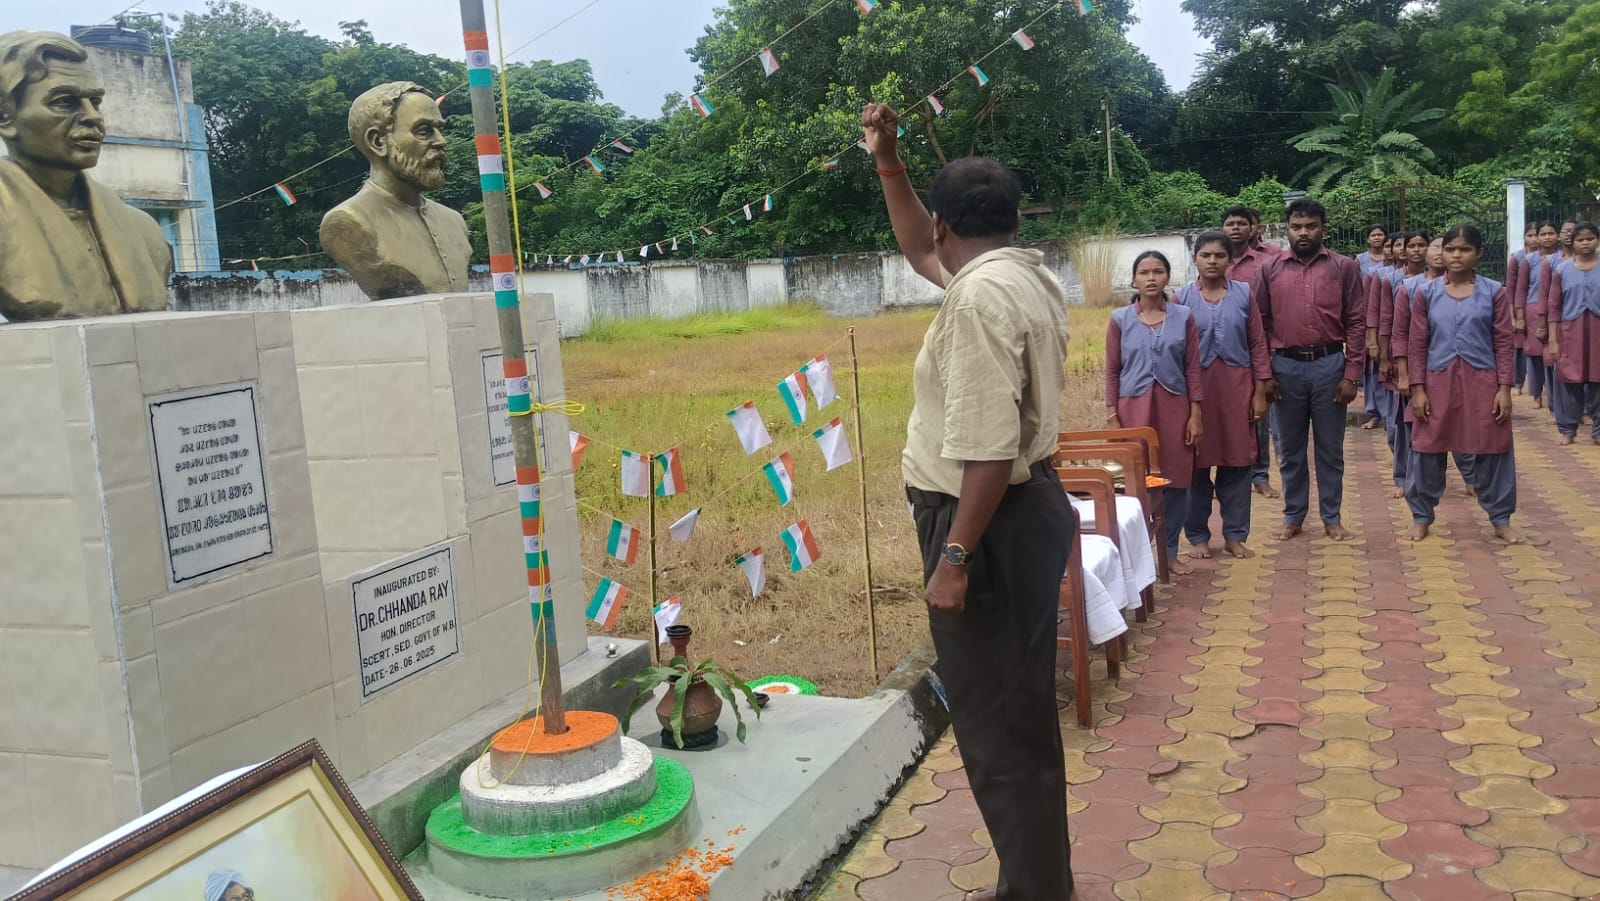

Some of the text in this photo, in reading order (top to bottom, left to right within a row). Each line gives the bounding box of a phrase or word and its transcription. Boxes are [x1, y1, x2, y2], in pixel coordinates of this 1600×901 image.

[374, 570, 426, 599] INAUGURATED
[429, 580, 449, 603] RAY
[380, 610, 436, 642] HON. DIRECTOR
[433, 625, 440, 637] OF
